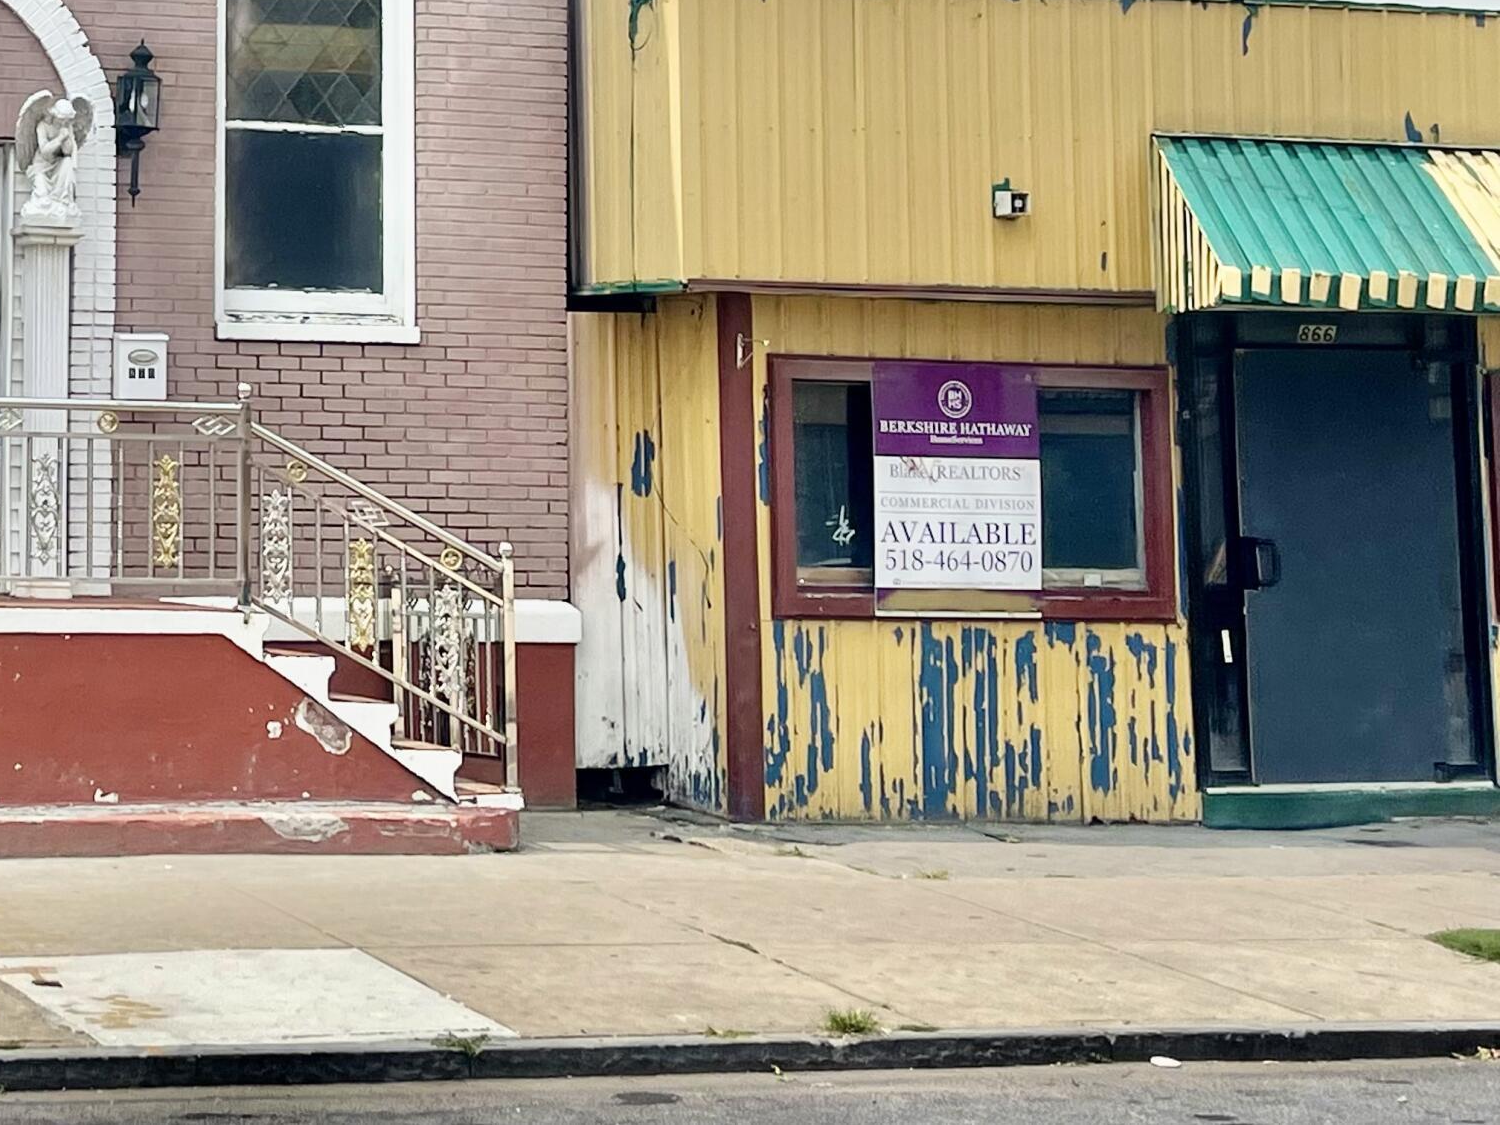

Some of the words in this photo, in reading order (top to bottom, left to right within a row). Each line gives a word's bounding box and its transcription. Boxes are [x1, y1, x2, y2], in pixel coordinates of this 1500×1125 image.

[1298, 325, 1335, 343] 866
[880, 420, 956, 435] BERKSHIRE
[961, 423, 1031, 437] HATHAWAY
[937, 465, 1021, 481] REALTORS
[881, 496, 970, 509] COMMERCIAL
[976, 499, 1035, 510] DIVISION
[881, 521, 1036, 545] AVAILABLE
[885, 549, 1033, 572] 518-464-0870
